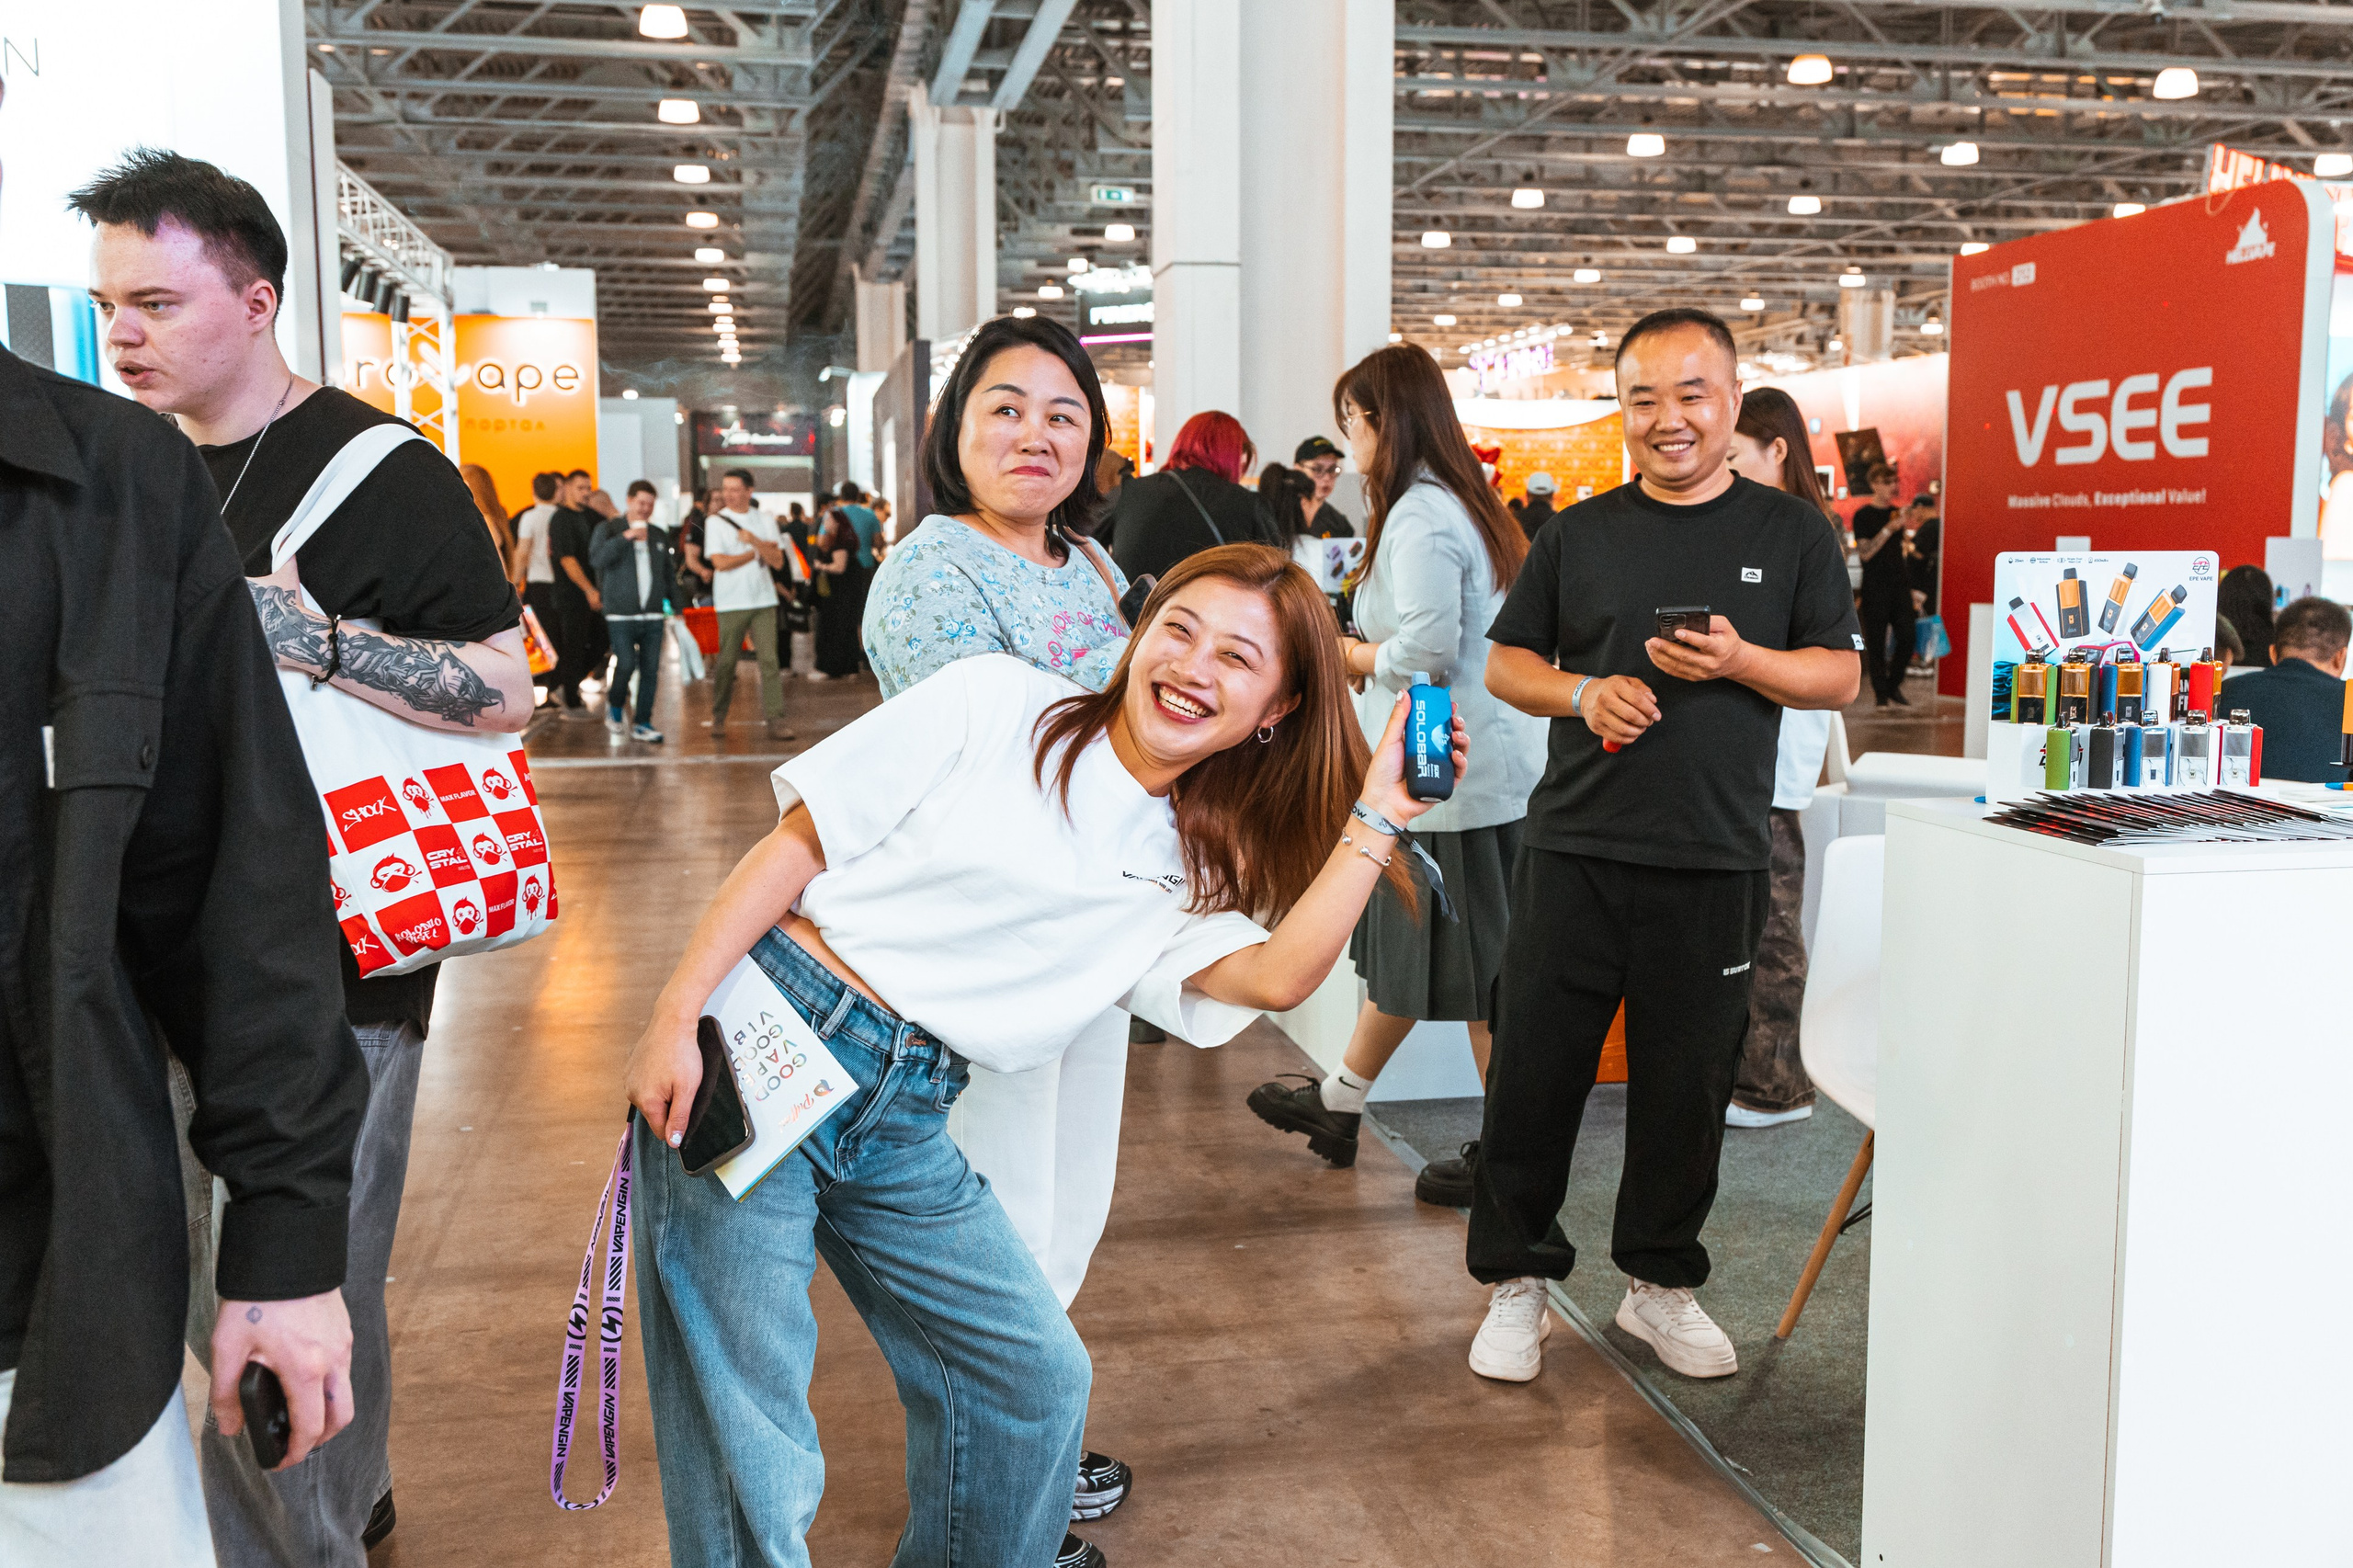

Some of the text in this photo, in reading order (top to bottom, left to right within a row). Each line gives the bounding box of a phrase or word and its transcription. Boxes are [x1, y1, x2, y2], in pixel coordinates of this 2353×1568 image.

[2006, 367, 2212, 467] VSEE
[2007, 492, 2051, 509] Massive
[2094, 487, 2165, 509] Exceptional
[2167, 486, 2207, 506] Value!
[341, 795, 397, 833] SHOCK
[439, 790, 477, 802] MAX FLAVOR
[426, 847, 455, 861] CRY
[506, 831, 531, 843] CRY
[509, 838, 543, 852] STAL
[429, 856, 468, 869] STAL
[488, 904, 501, 913] MAX
[733, 1024, 783, 1073] GOOD
[742, 1039, 798, 1087] VAPE
[755, 1052, 807, 1101] GOOD
[612, 1176, 630, 1253] VAPENGIN
[556, 1392, 575, 1458] VAPENGIN
[603, 1392, 616, 1460] VAPENGIN
